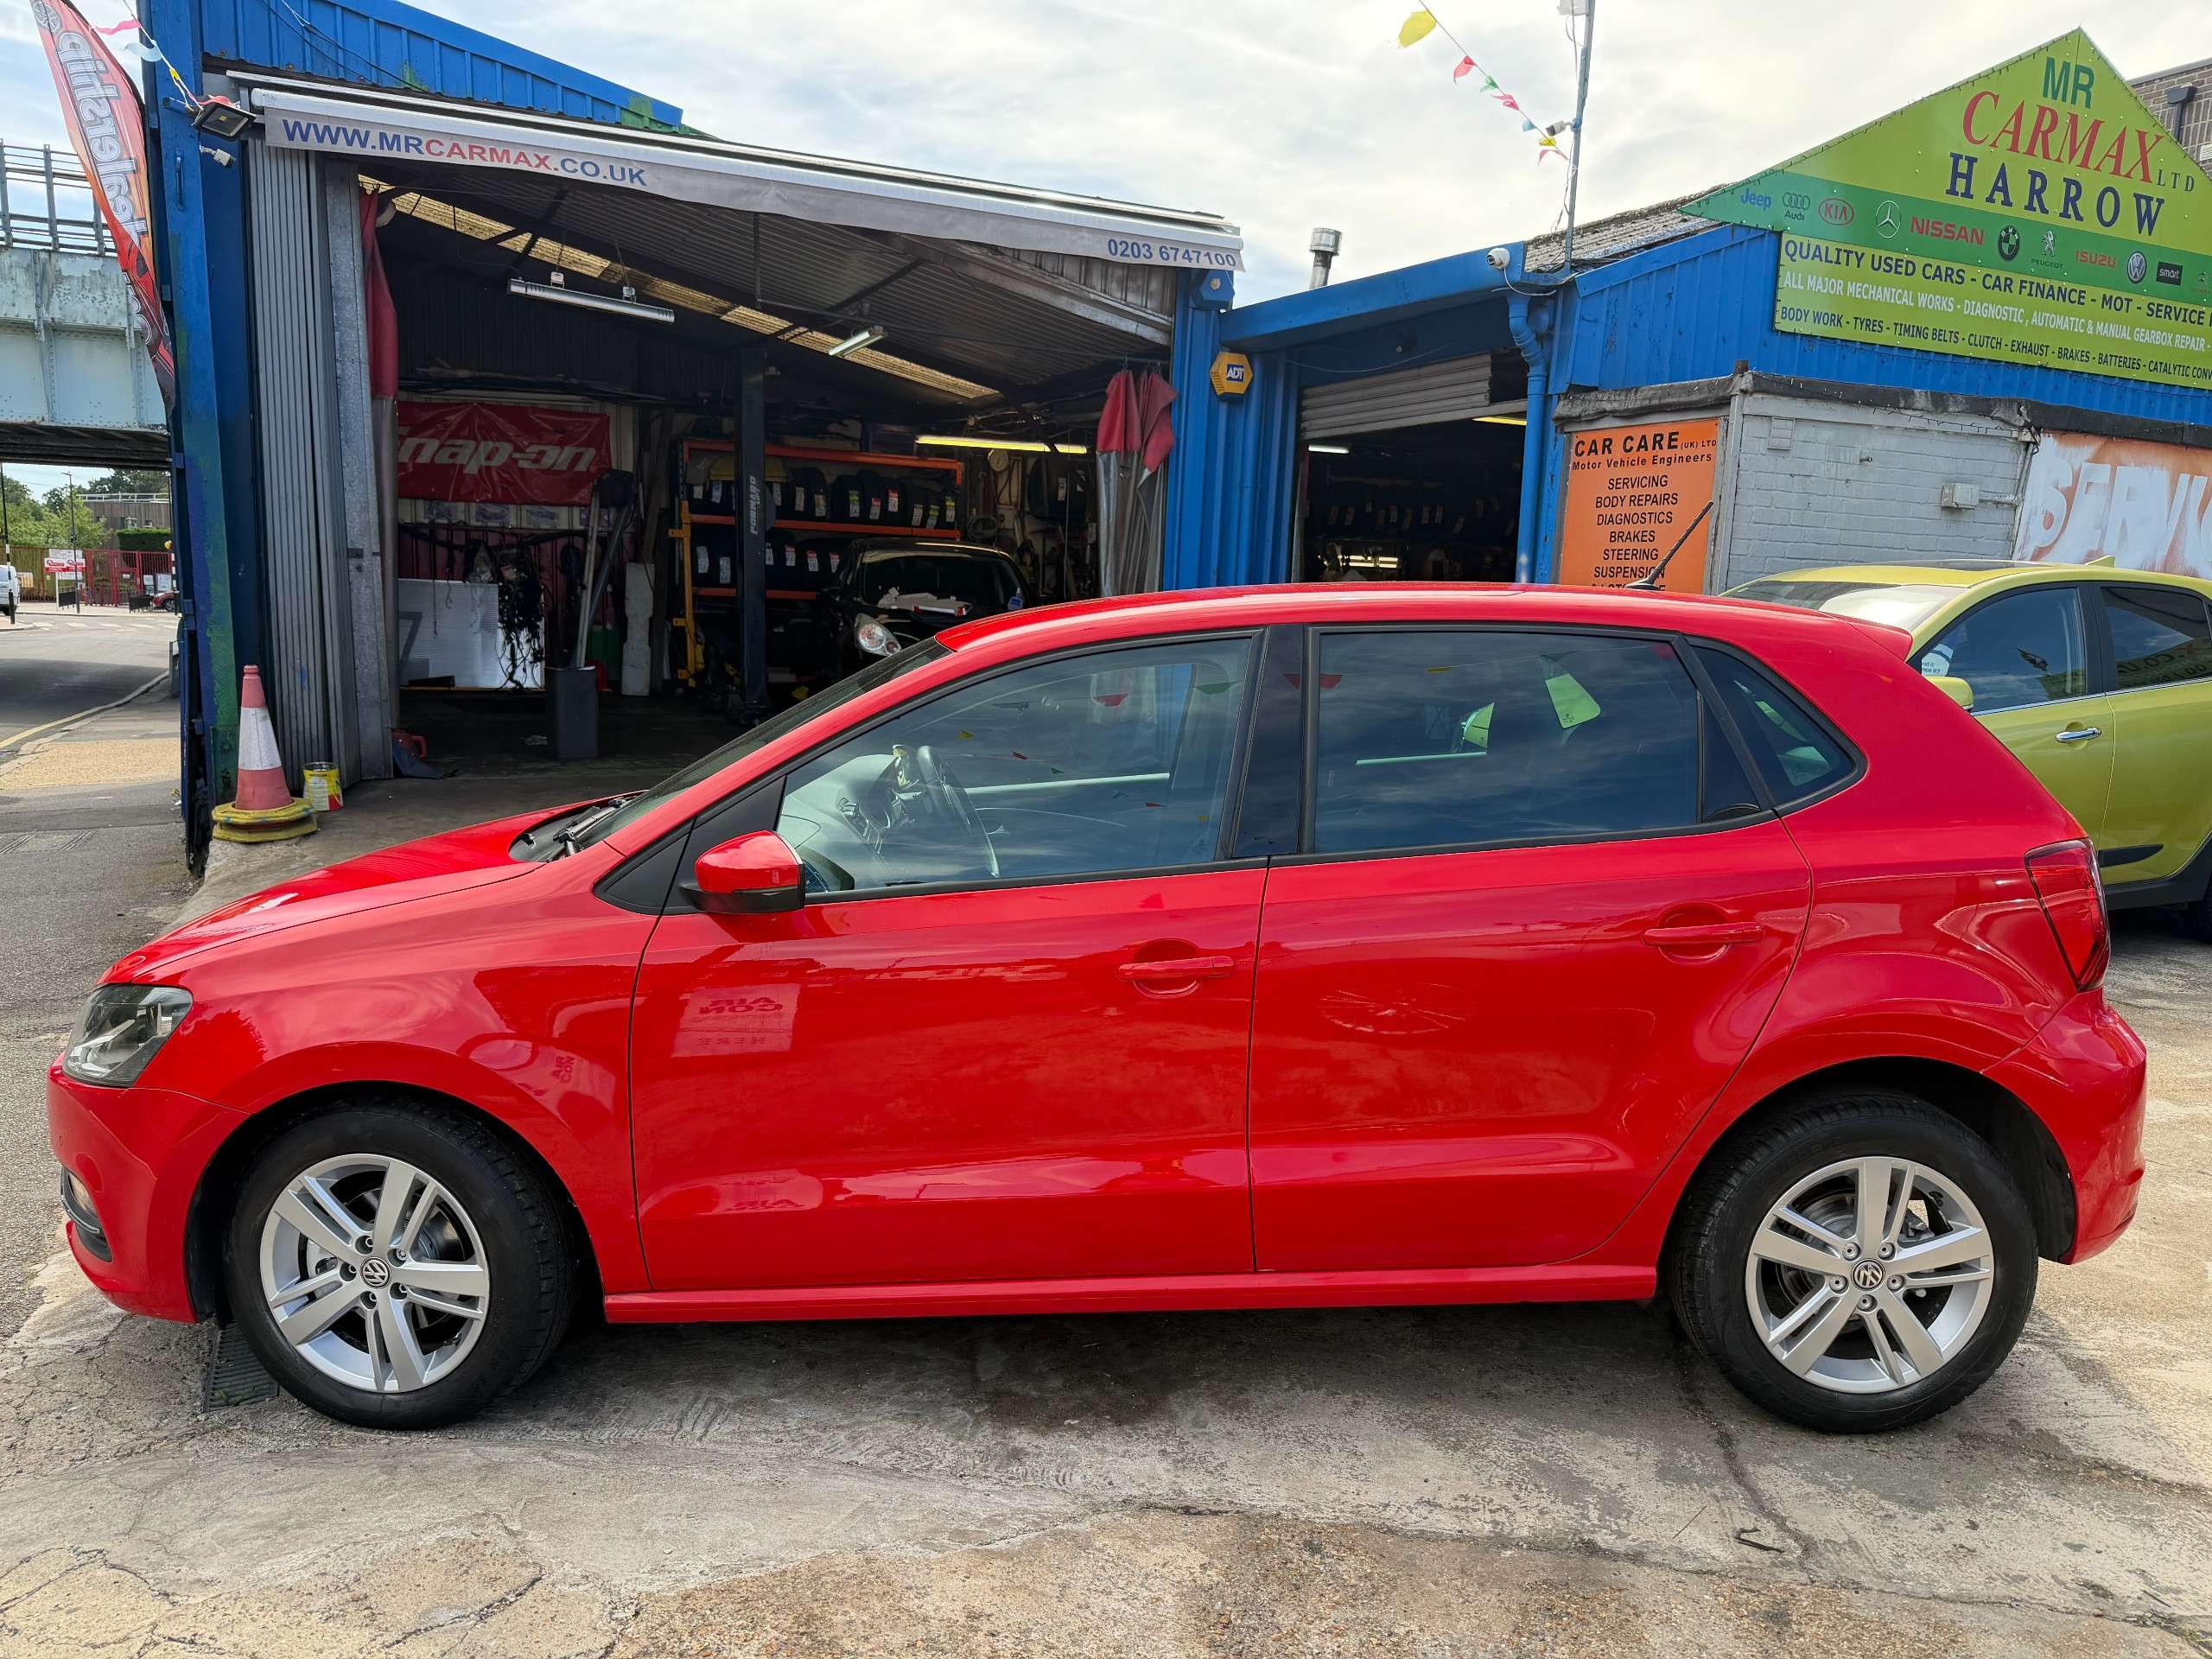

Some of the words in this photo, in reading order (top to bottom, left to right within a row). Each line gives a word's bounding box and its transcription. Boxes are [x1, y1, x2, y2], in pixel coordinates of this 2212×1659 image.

[2043, 56, 2094, 109] MR
[282, 118, 648, 187] WWW.MRCARMAX.CO.UK
[1962, 91, 2164, 184] CARMAX
[2157, 169, 2195, 192] LTD
[1740, 188, 1771, 211] Jeep
[1945, 152, 2165, 237] HARROW
[1784, 210, 1805, 222] Audi
[1824, 203, 1848, 223] KIA
[1910, 216, 1985, 246] NISSAN
[1108, 238, 1153, 260] 0203
[1159, 245, 1236, 267] 6747100
[2075, 249, 2117, 270] ISUZU
[2031, 259, 2063, 270] PEUGEOT
[2159, 267, 2180, 281] smart
[1784, 239, 1866, 269] QUALITY
[1872, 253, 1916, 276] USED
[1922, 264, 1966, 285] CARS
[1982, 273, 2013, 294] CAR
[2018, 280, 2087, 306] FINANCE
[2101, 294, 2133, 314] MOT
[2145, 302, 2205, 326] SERVICE
[1783, 271, 1804, 290] ALL
[1807, 276, 1844, 296] MAJOR
[1847, 282, 1914, 307] MECHANICAL
[1917, 292, 1955, 313] WORKS
[2031, 311, 2085, 334] AUTOMATIC
[2087, 320, 2094, 334] &
[2095, 321, 2132, 341] MANUAL
[2133, 327, 2174, 346] GEARBOX
[2174, 334, 2205, 352] REPAIR
[1781, 306, 1810, 322] BODY
[1814, 310, 1844, 328] WORK
[1853, 317, 1884, 334] TYRES
[1893, 322, 1929, 340] TIMING
[1931, 328, 1959, 344] BELTS
[1967, 333, 2002, 350] CLUTCH
[2011, 339, 2050, 357] EXHAUST
[2057, 346, 2090, 363] BRAKES
[2098, 353, 2141, 371] BATTERIES
[2148, 360, 2191, 378] CATALYTIC
[1226, 366, 1244, 380] ADT
[397, 426, 597, 475] nap-on
[1574, 437, 1613, 457] CAR
[1622, 431, 1680, 454] CARE
[1681, 441, 1699, 450] (UK)
[1701, 439, 1717, 448] LTD
[1572, 461, 1602, 471] Motor
[1606, 456, 1647, 469] Vehicle
[1651, 453, 1712, 467] Engineers
[1607, 474, 1669, 490] SERVICING
[1595, 495, 1626, 509] BODY
[1629, 493, 1678, 507] REPAIRS
[1597, 511, 1673, 526] DIAGNOSTICS
[1609, 530, 1656, 543] BRAKES
[1603, 549, 1659, 561] STEERING
